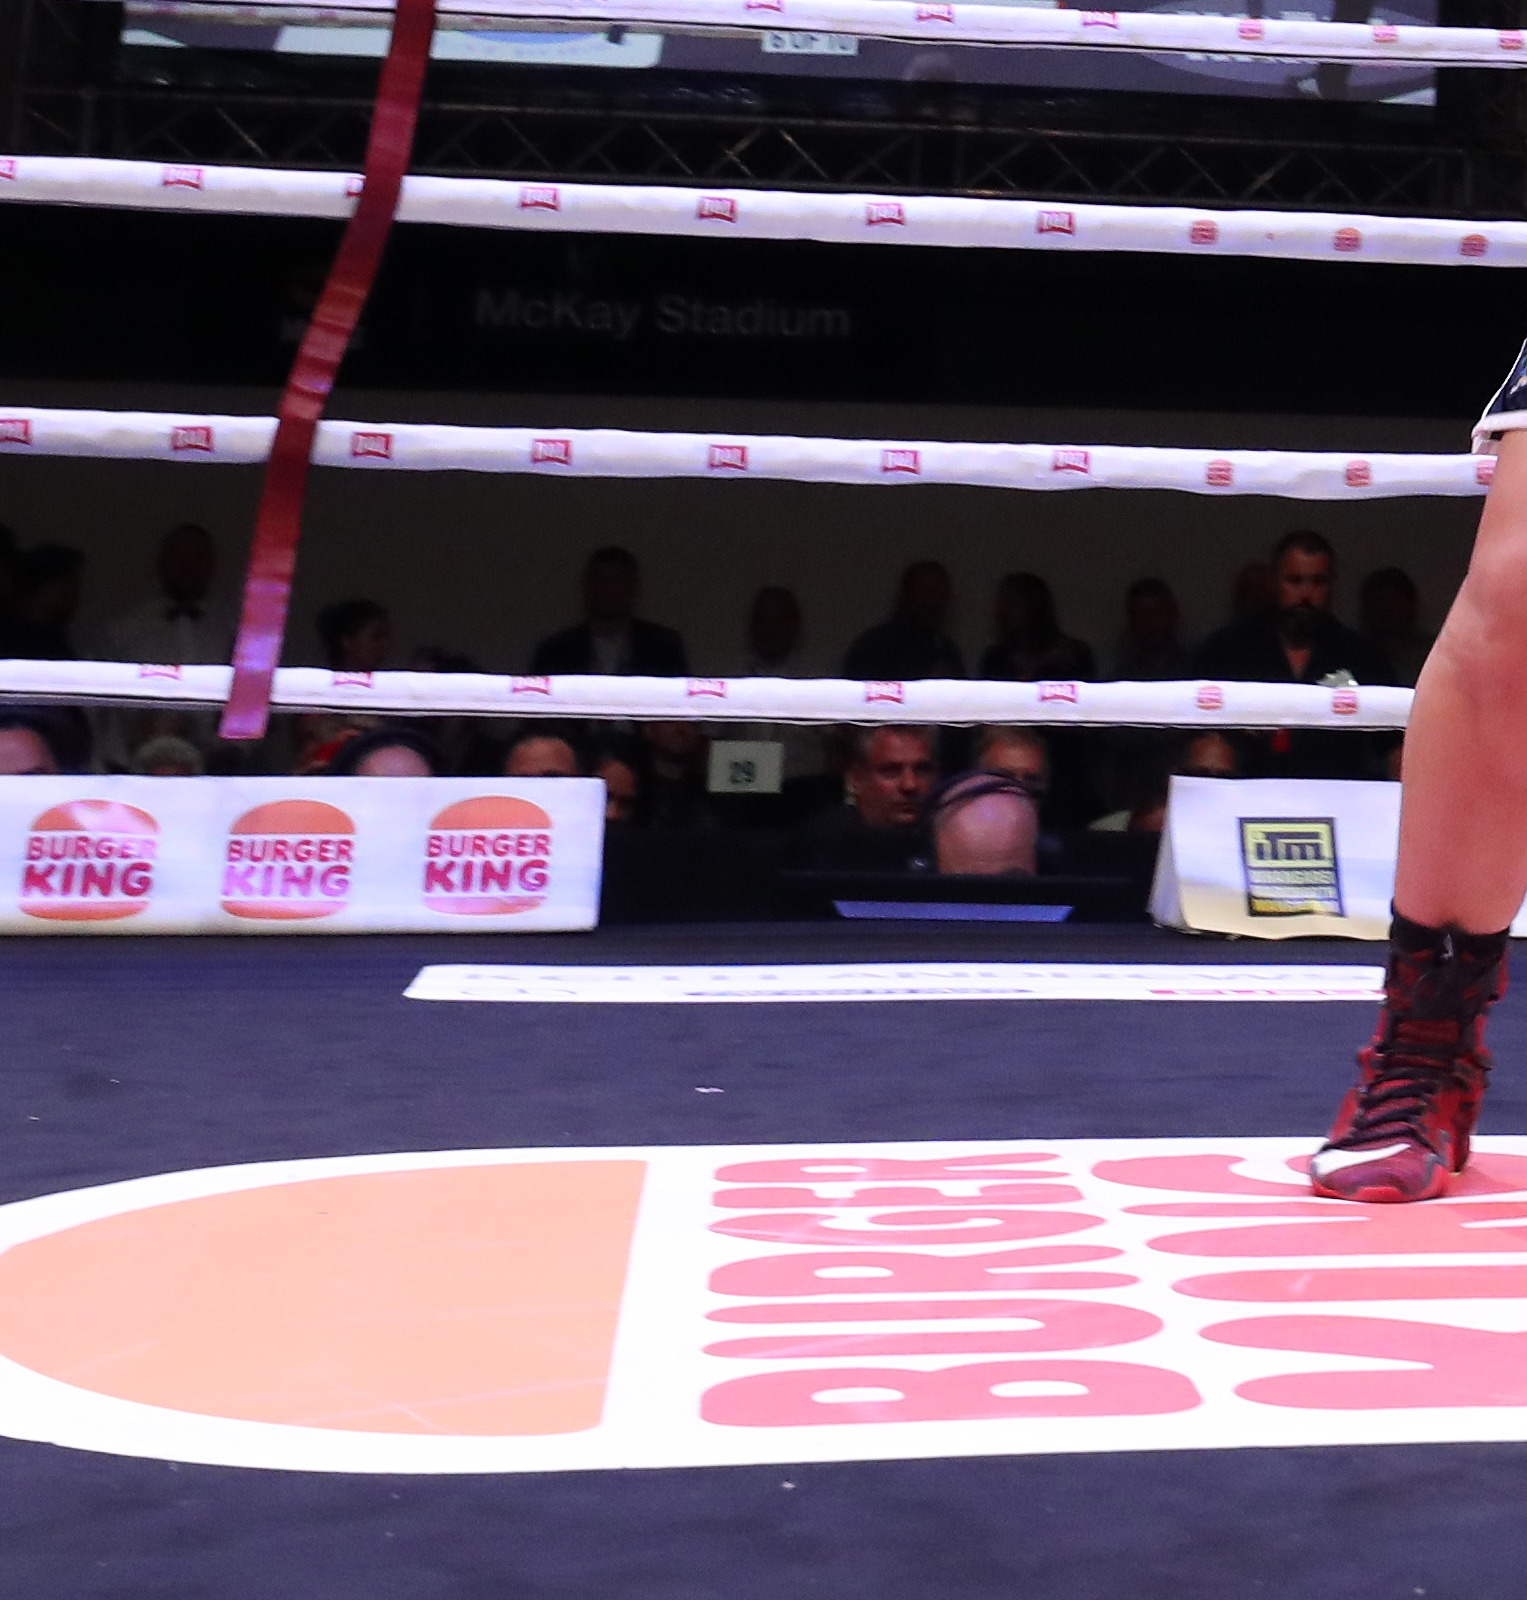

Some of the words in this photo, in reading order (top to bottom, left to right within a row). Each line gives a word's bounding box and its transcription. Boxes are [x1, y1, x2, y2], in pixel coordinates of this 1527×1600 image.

[475, 287, 641, 340] McKay
[656, 296, 853, 338] Stadium
[26, 836, 157, 861] BURGER
[226, 839, 354, 862] BURGER
[425, 834, 551, 857] BURGER
[21, 862, 153, 897] KING
[222, 865, 352, 898] KING
[424, 860, 550, 892] KING
[700, 1153, 1202, 1428] BURGER
